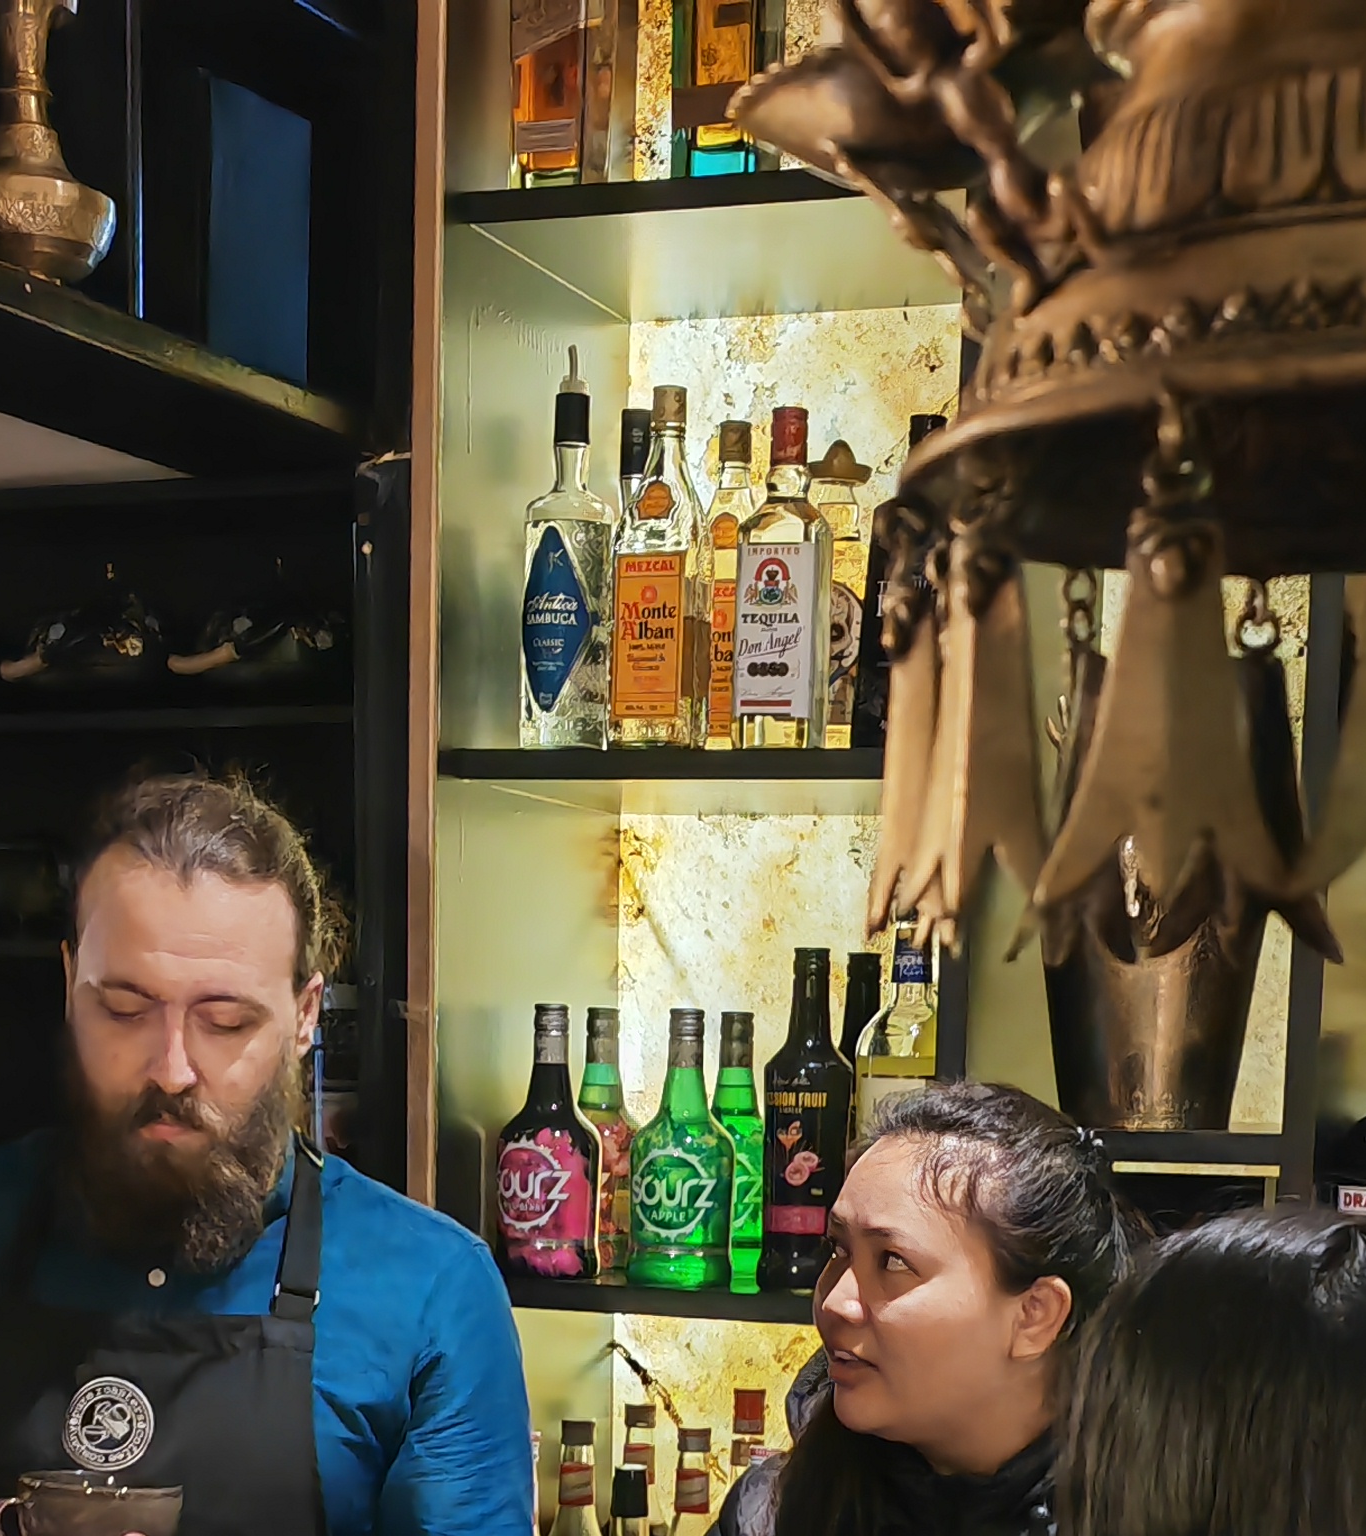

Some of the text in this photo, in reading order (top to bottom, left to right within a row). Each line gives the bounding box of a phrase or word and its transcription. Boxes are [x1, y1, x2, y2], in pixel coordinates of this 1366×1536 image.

[747, 547, 801, 556] IMPORTED
[625, 560, 675, 572] MEZCAL
[527, 592, 578, 612] Antica
[620, 601, 677, 620] Monte
[526, 612, 578, 626] SAMBUCA
[741, 613, 800, 627] TEQUILA
[620, 620, 675, 641] Alban
[737, 637, 764, 658] Don
[767, 626, 803, 659] Angel
[798, 1091, 828, 1108] FRUIT
[499, 1168, 572, 1200] ourz
[632, 1174, 717, 1208] sourz
[651, 1209, 686, 1222] APPLE
